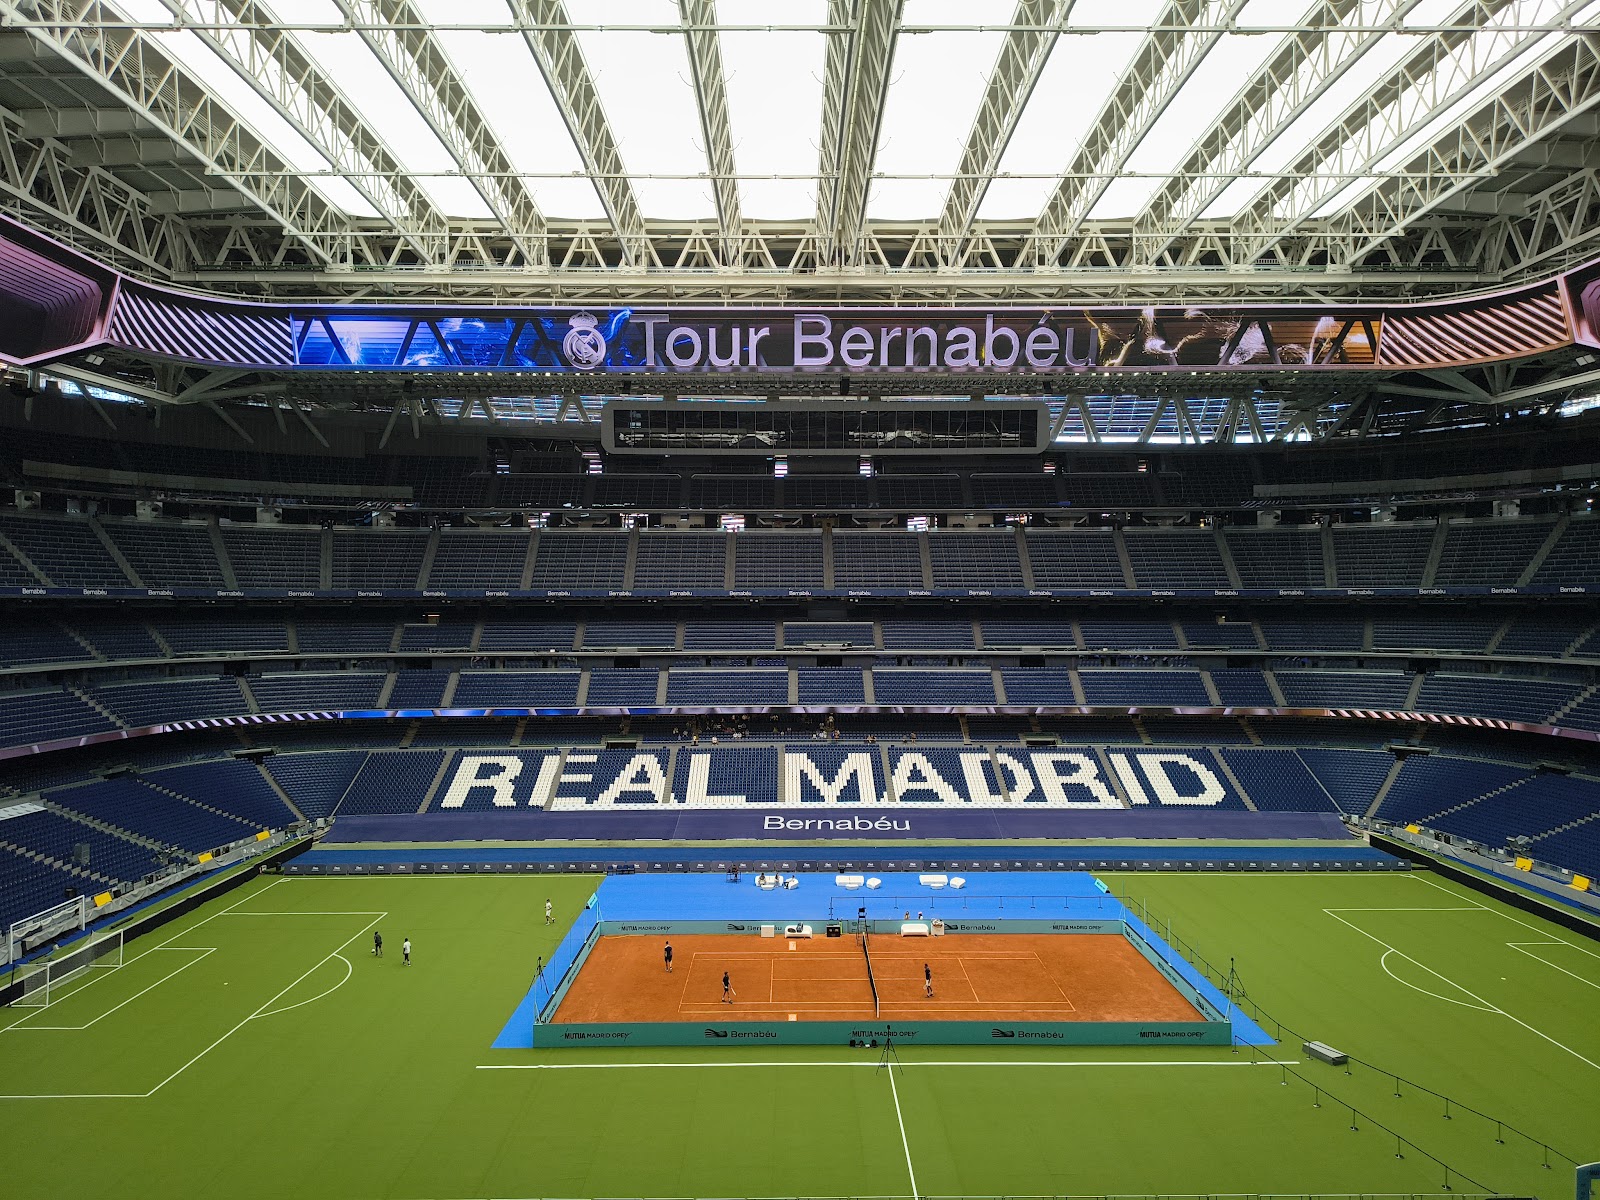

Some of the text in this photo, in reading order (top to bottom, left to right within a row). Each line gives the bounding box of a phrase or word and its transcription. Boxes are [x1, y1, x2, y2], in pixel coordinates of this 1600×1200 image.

[629, 312, 1098, 366] Tour Bernabéu
[441, 752, 1227, 807] REAL MADRID
[763, 815, 911, 832] Bernabéu
[960, 923, 996, 931] Bernabéu
[563, 1031, 586, 1039] MUTUA
[730, 1030, 777, 1039] Bernabéu
[851, 1029, 874, 1037] MUTUA
[1017, 1030, 1064, 1039] Bernabéu
[1138, 1030, 1161, 1038] MUTUA
